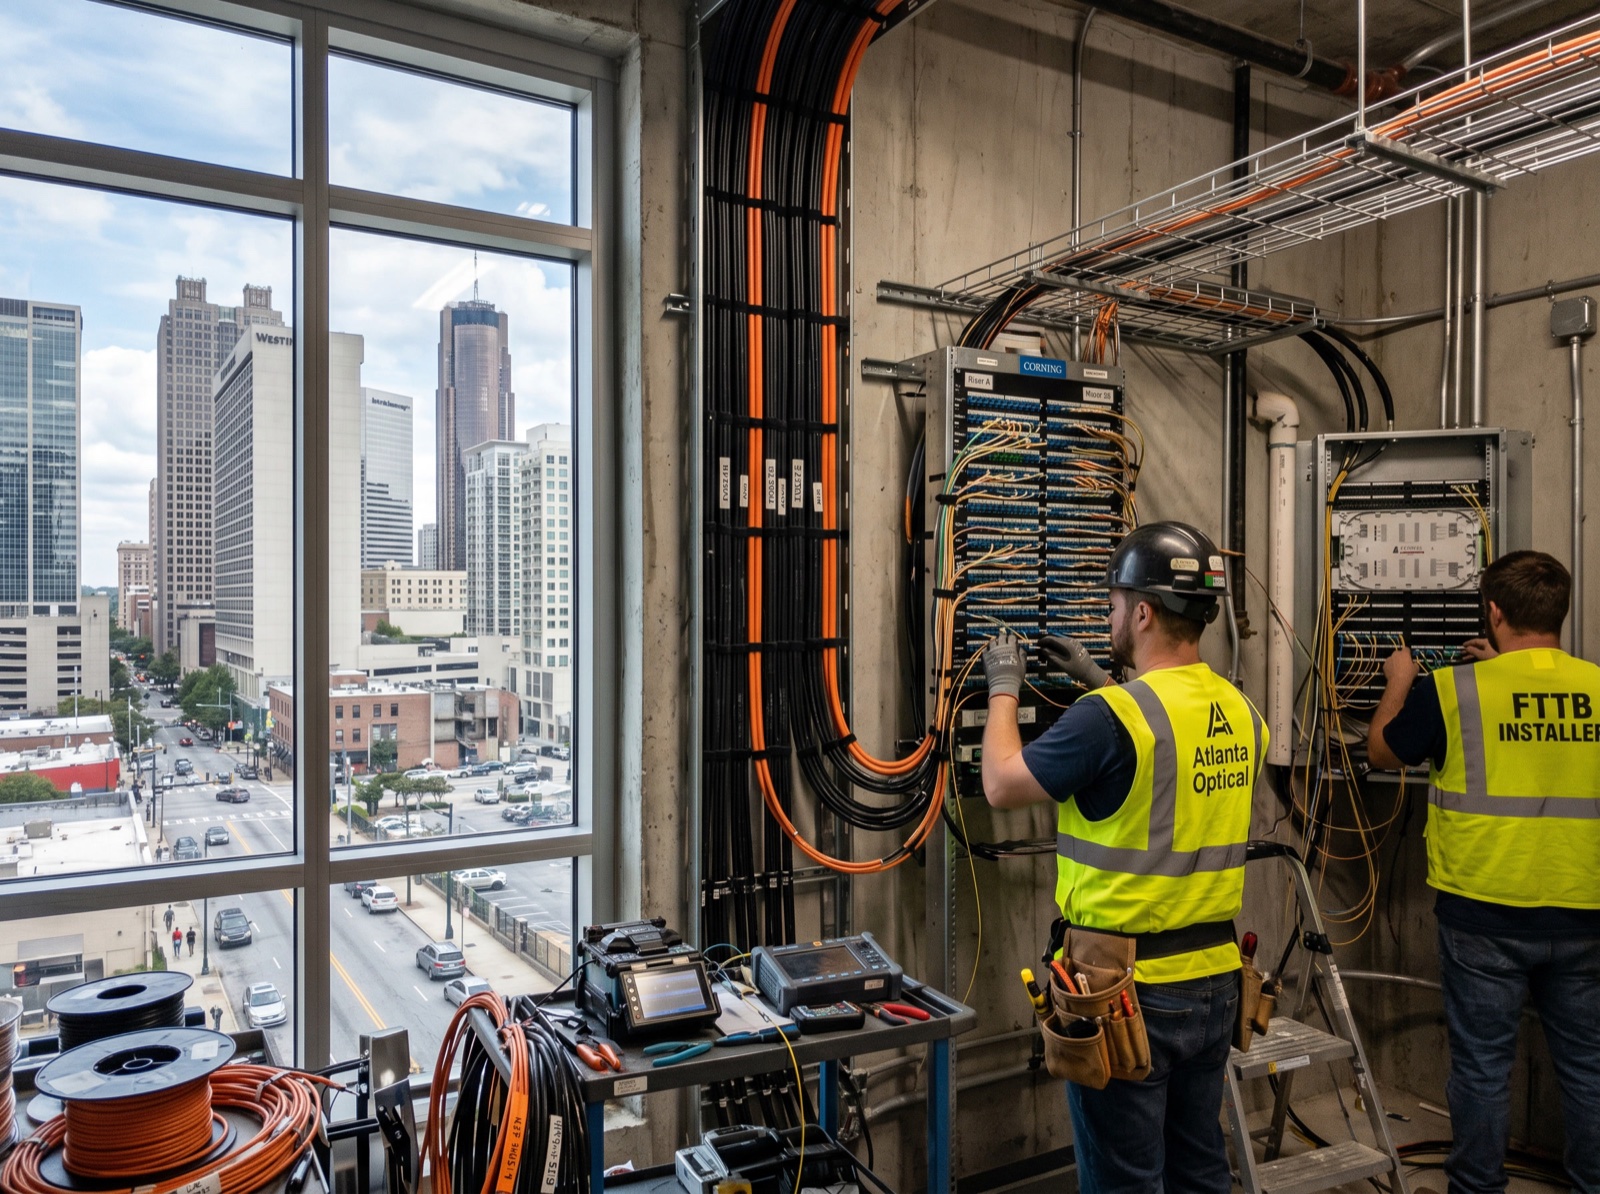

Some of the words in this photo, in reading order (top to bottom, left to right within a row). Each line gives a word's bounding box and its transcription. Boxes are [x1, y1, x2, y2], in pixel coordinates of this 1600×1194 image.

[1023, 361, 1062, 374] CORNING
[968, 375, 984, 385] Riser
[985, 378, 991, 386] A
[1512, 692, 1592, 719] FTTB
[1193, 743, 1249, 768] Atlanta
[1193, 765, 1249, 797] Optical
